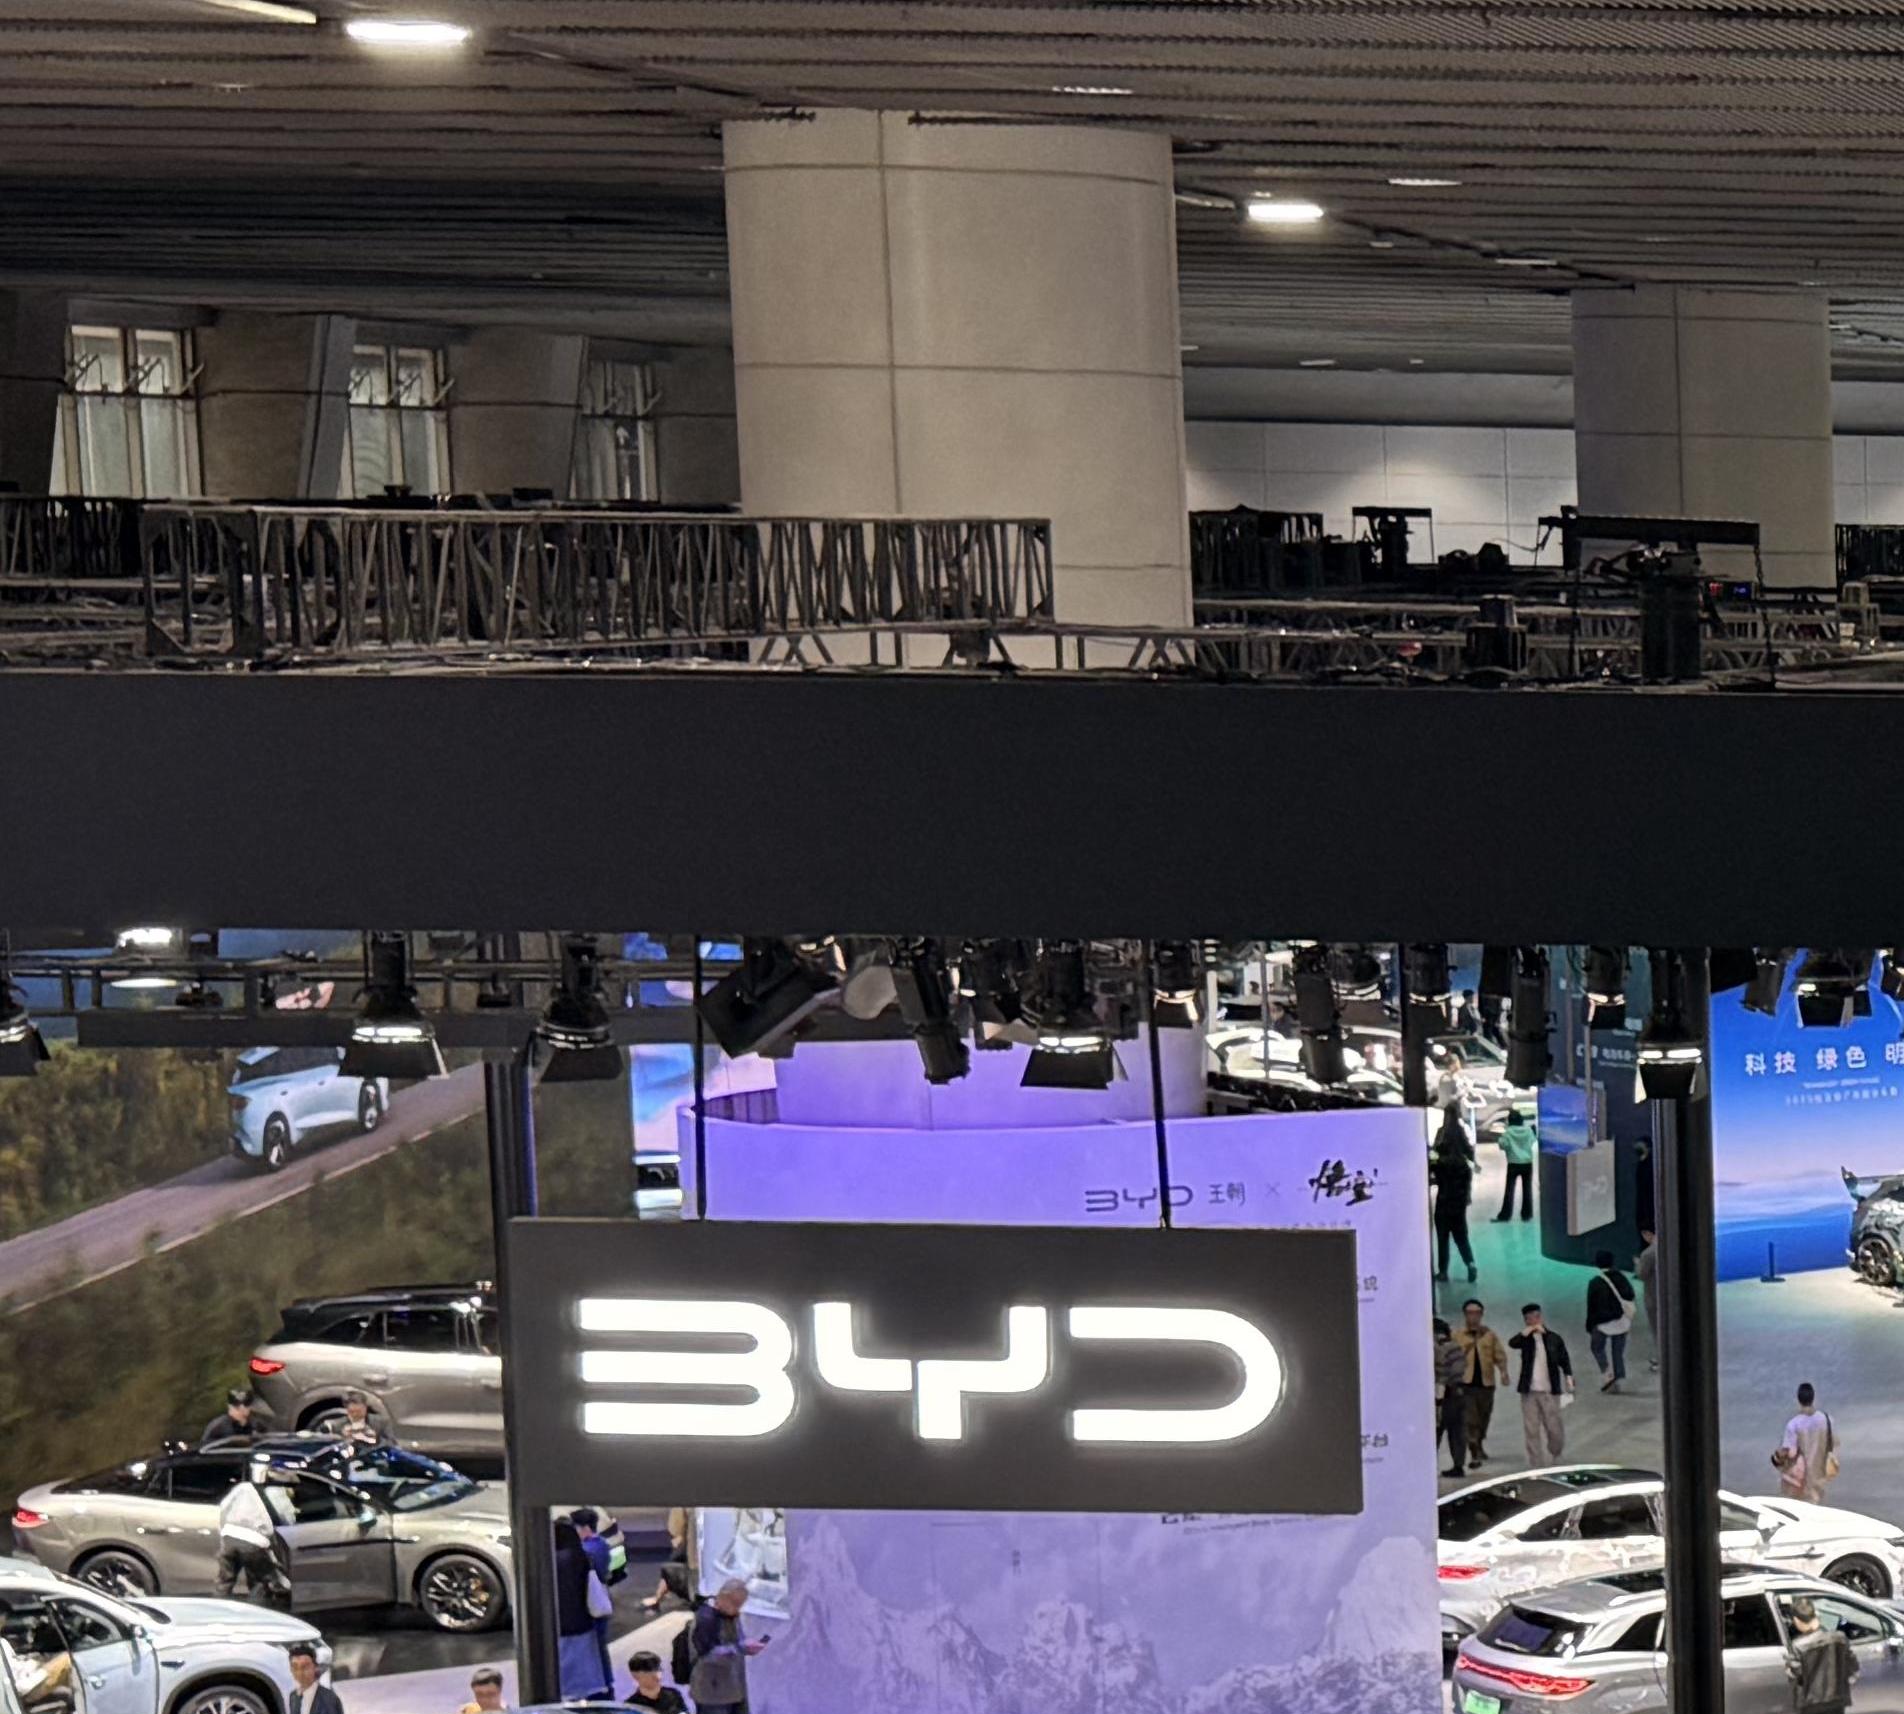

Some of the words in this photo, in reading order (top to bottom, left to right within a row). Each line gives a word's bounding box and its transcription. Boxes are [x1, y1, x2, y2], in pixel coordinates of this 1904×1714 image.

[1745, 1051, 1797, 1076] 科技
[1816, 1045, 1868, 1071] 绿色
[1085, 1184, 1194, 1212] BYD
[1208, 1182, 1246, 1206] 王朝
[578, 1298, 1284, 1443] BYD
